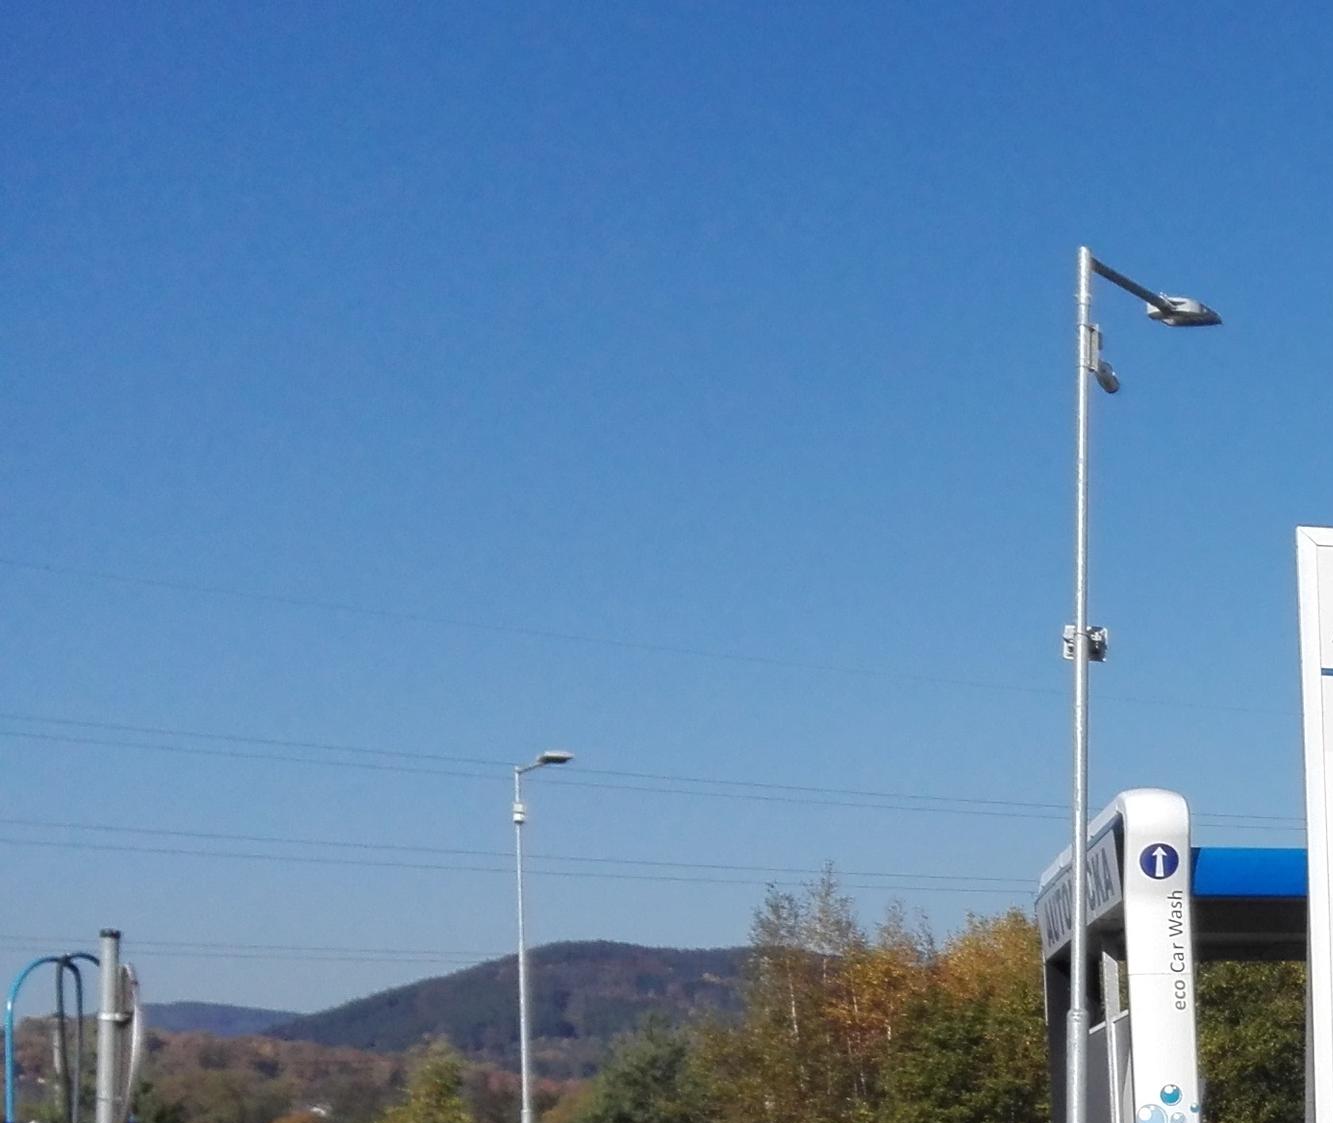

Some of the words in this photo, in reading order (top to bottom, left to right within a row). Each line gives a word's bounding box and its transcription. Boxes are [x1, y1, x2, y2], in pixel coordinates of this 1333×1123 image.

[1167, 890, 1183, 937] Wash
[1170, 943, 1185, 973] Car
[1174, 980, 1186, 1010] eco
